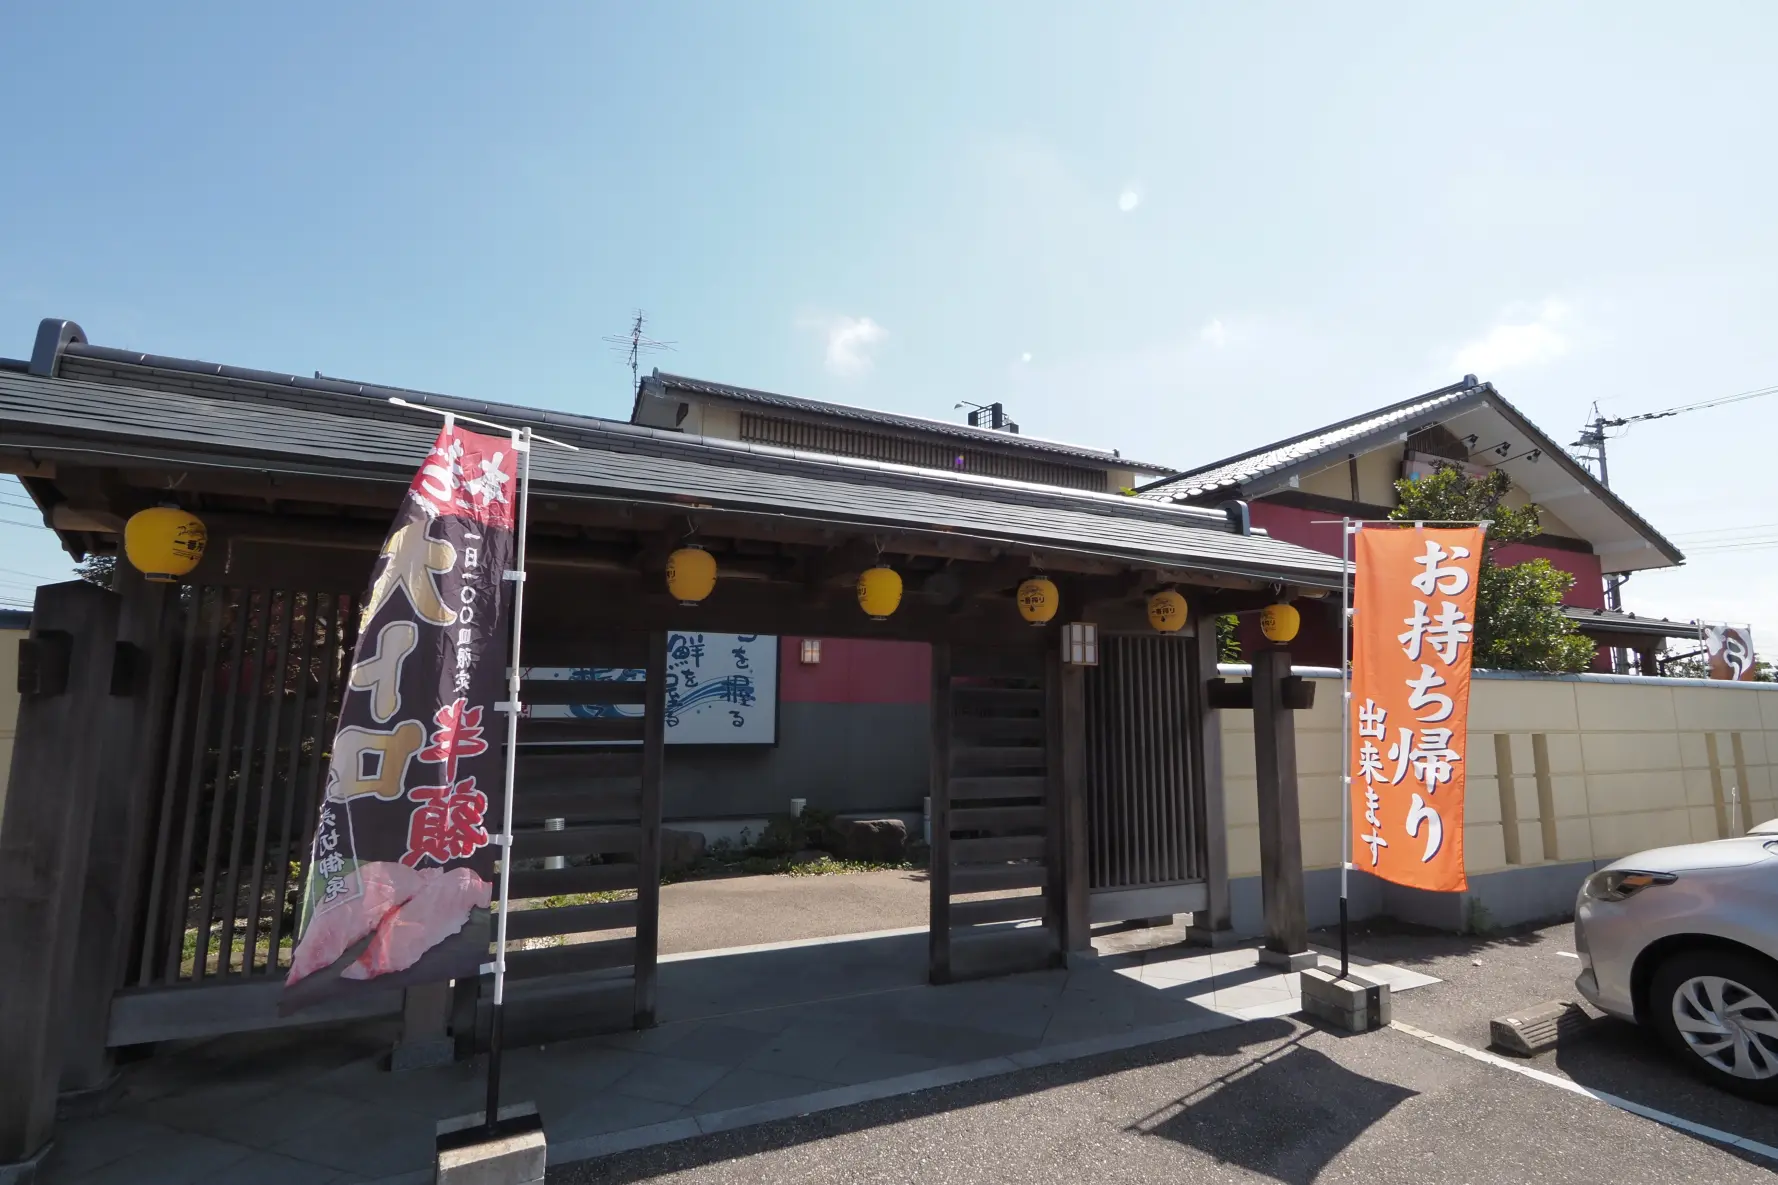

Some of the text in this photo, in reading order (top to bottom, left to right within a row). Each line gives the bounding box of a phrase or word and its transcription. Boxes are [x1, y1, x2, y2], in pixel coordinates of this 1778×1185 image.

[1357, 698, 1389, 867] 出来ます
[1388, 540, 1473, 864] お持ち帰り
